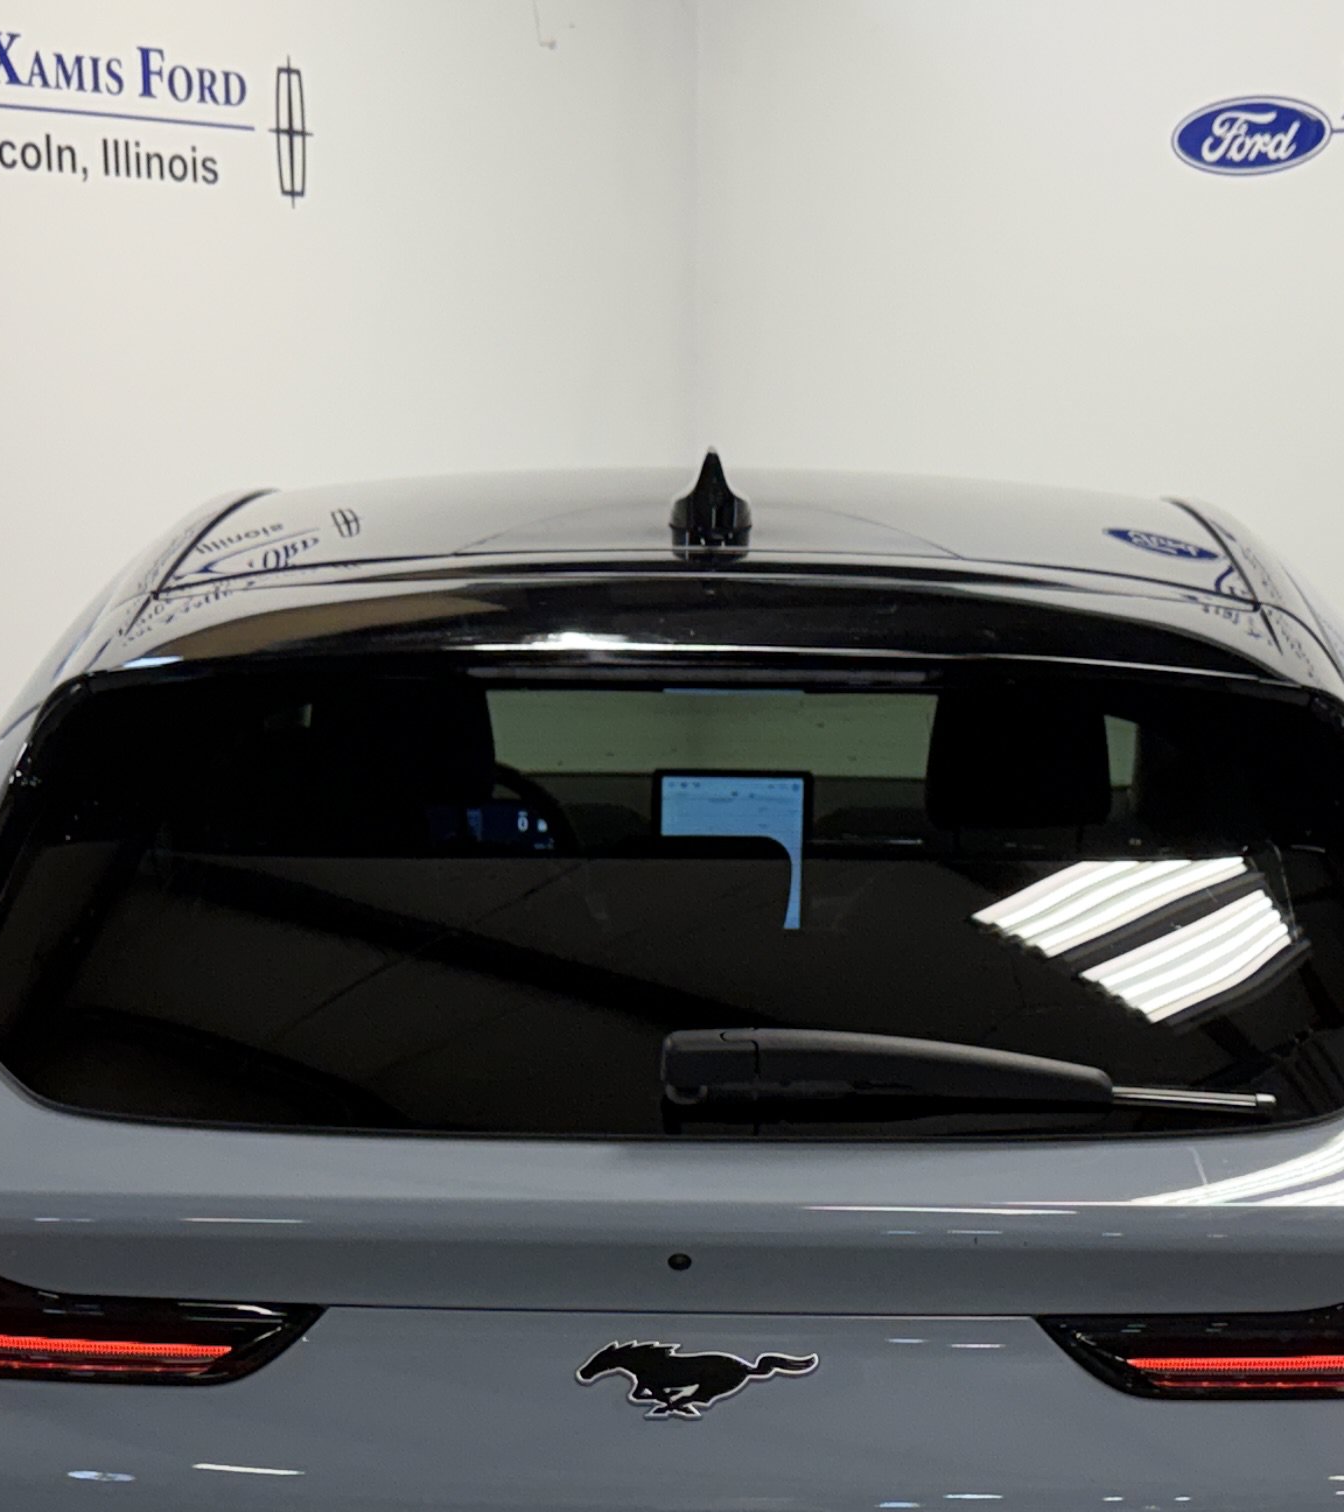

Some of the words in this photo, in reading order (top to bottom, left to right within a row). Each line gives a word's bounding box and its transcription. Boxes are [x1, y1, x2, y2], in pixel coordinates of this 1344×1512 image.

[137, 46, 247, 107] FORD
[101, 138, 219, 185] Illinois
[1200, 110, 1299, 163] Ford
